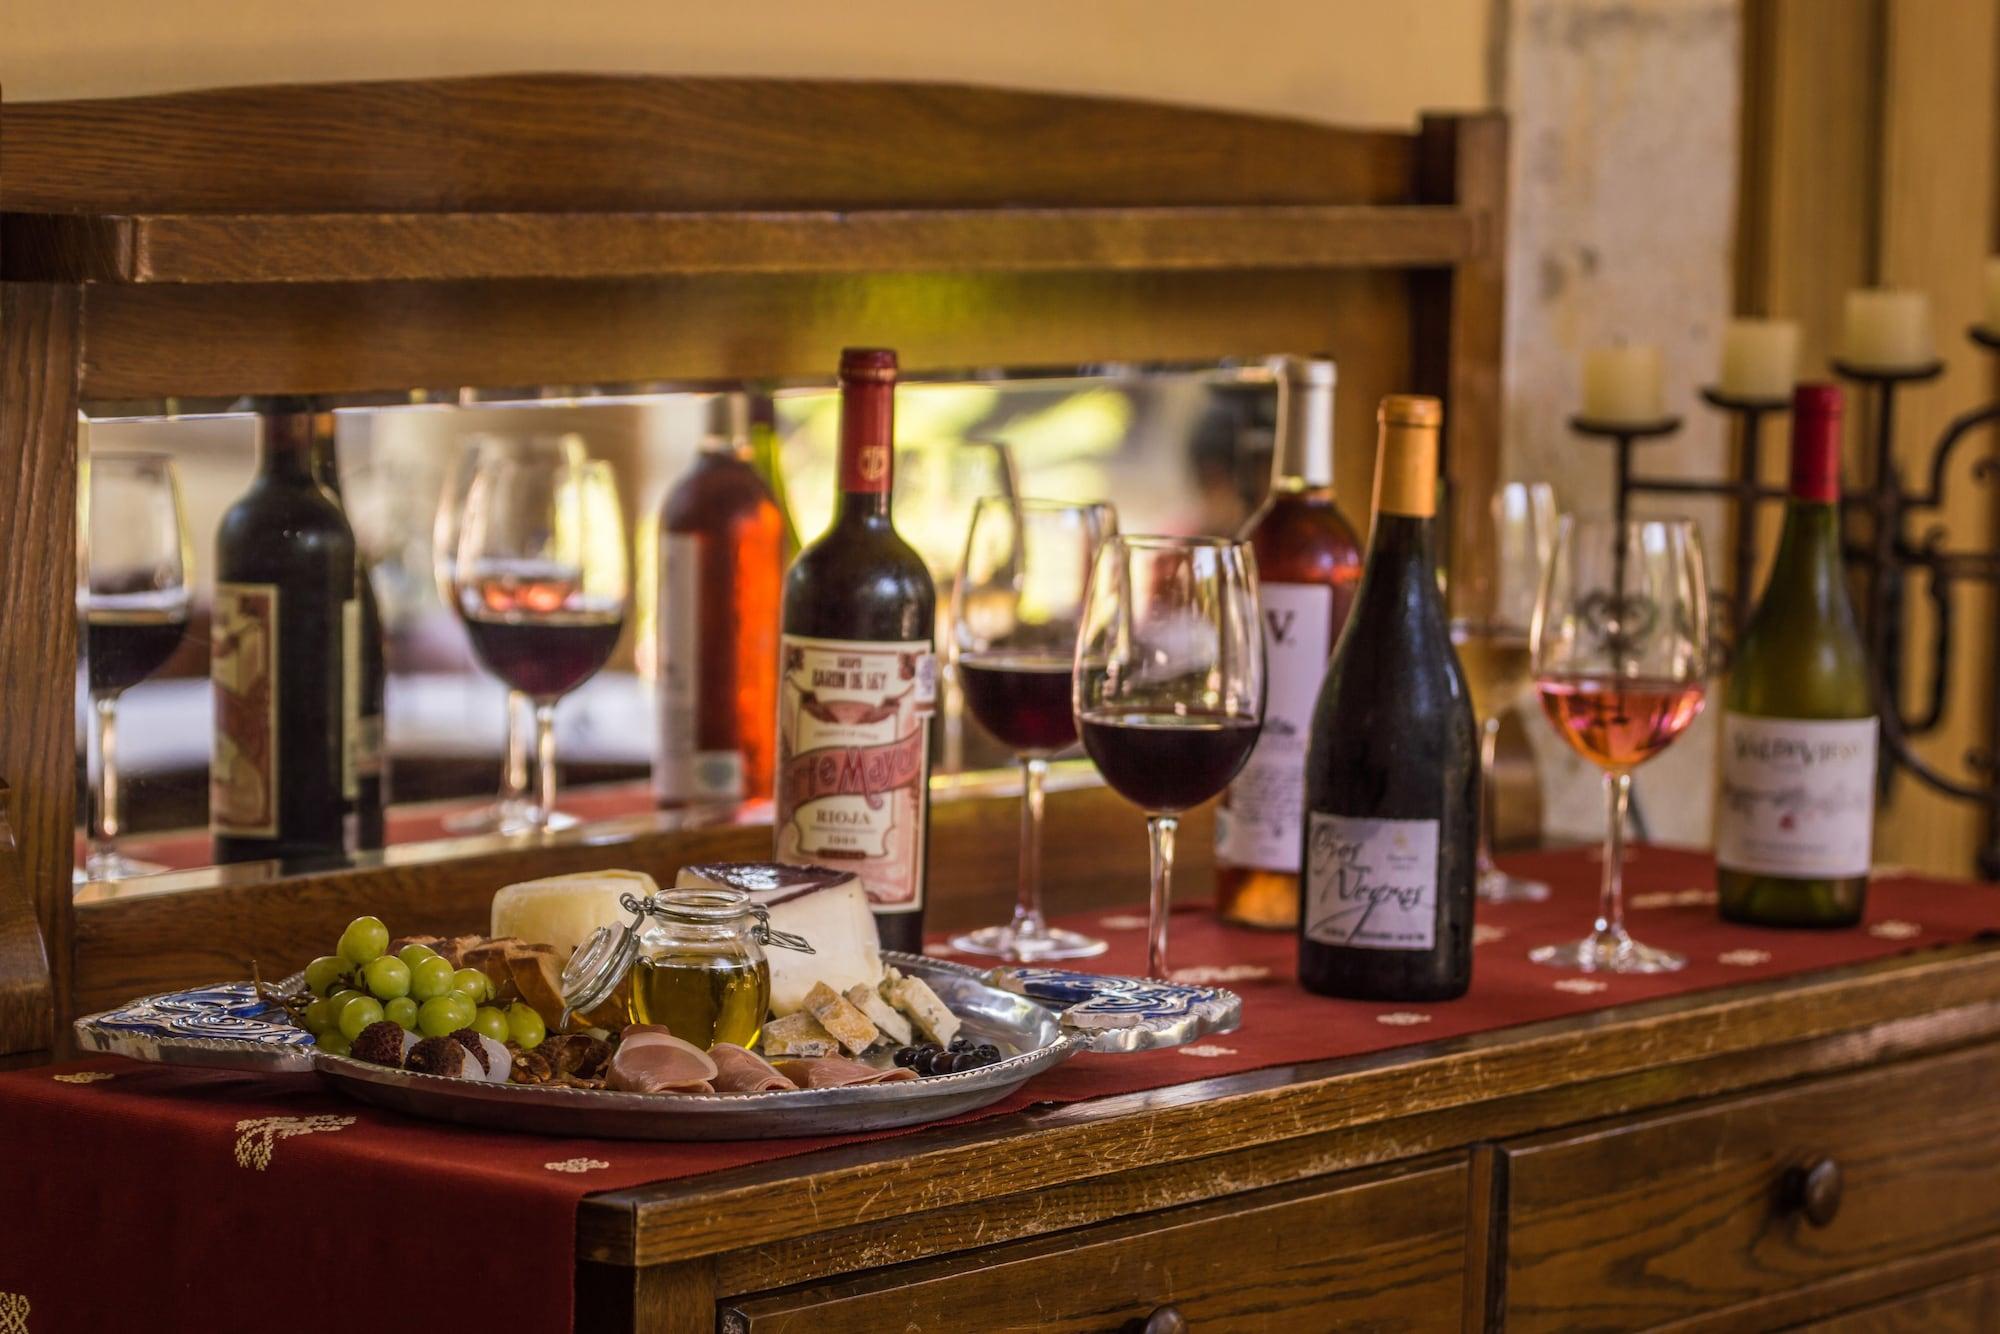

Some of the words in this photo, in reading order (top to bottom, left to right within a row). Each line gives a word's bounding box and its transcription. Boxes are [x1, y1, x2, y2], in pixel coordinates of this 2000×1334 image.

[811, 670, 846, 689] BARON
[849, 671, 863, 689] DE
[866, 672, 888, 690] LEY
[816, 809, 872, 826] RIOJA
